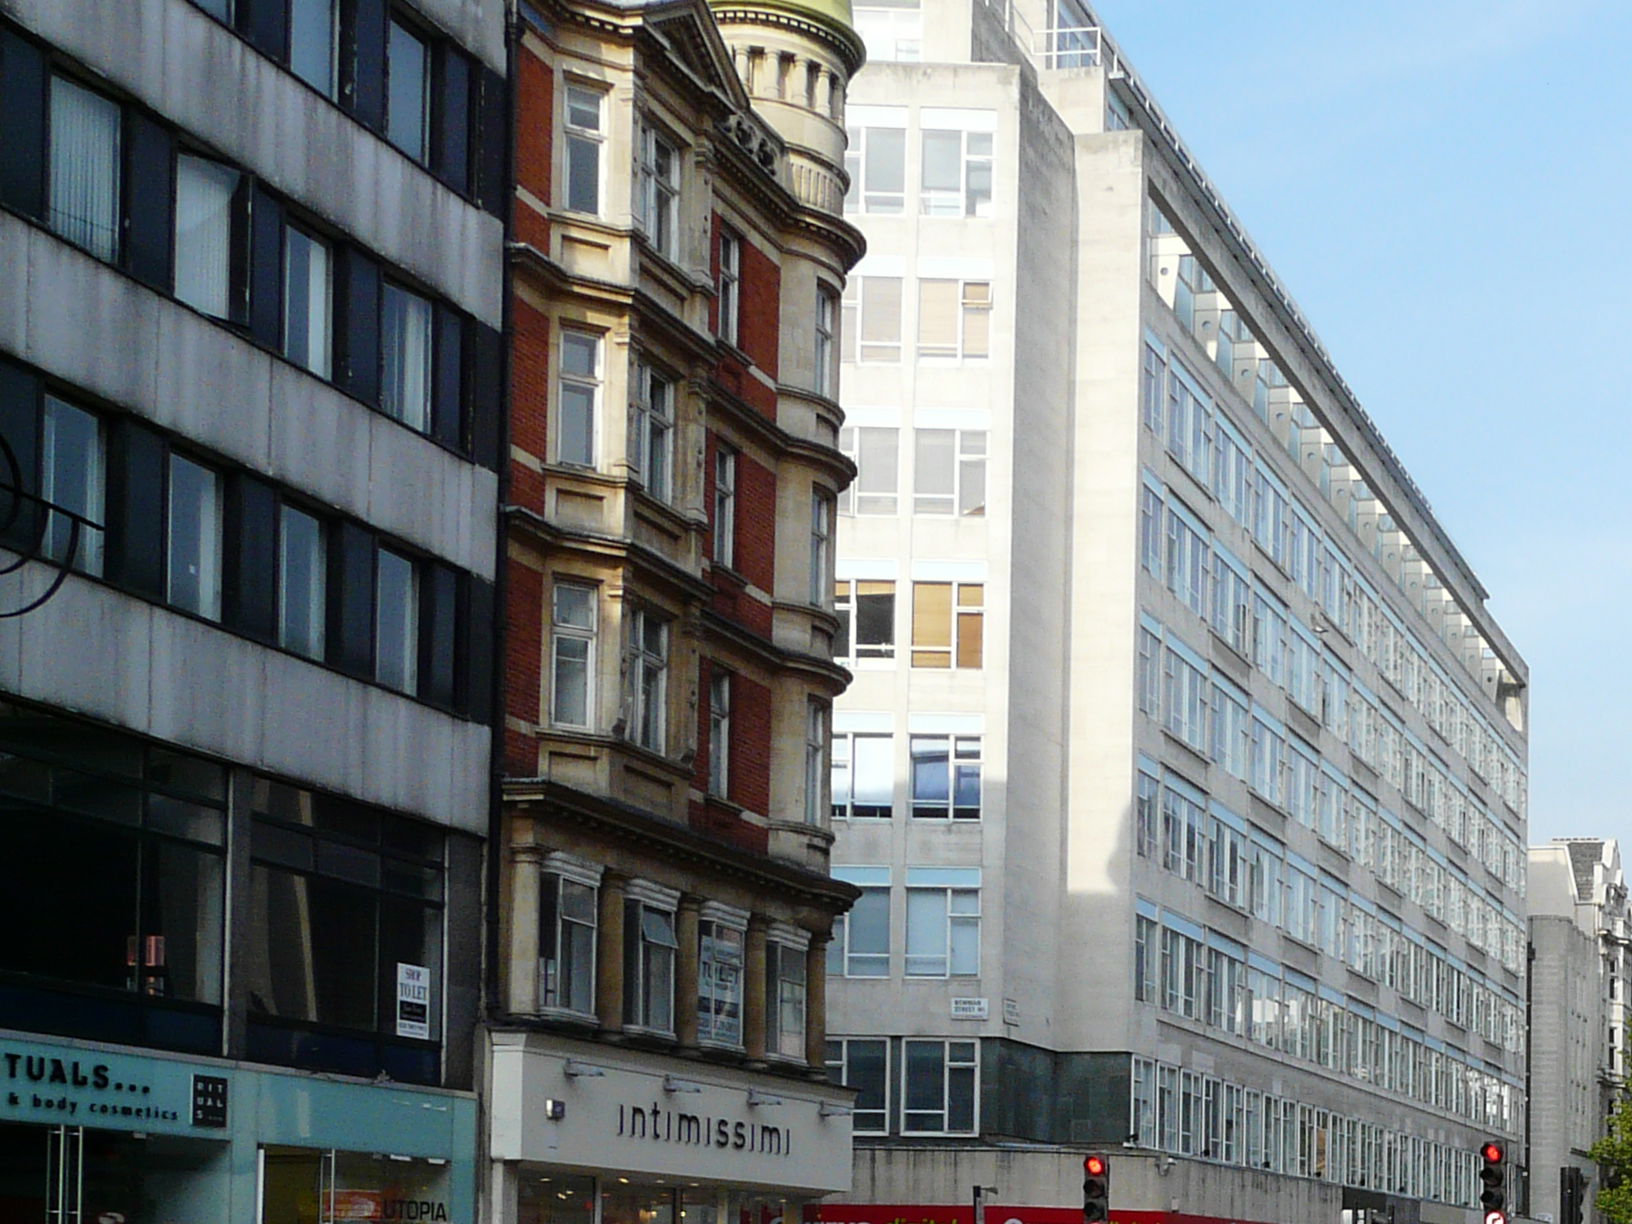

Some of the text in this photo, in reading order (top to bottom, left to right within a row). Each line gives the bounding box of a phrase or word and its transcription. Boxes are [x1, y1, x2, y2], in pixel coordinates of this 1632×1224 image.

[399, 983, 427, 1001] TO LET
[9, 1092, 178, 1120] & body cosmetics
[617, 1101, 791, 1156] intimissimi
[384, 1200, 447, 1221] UTOPIA
